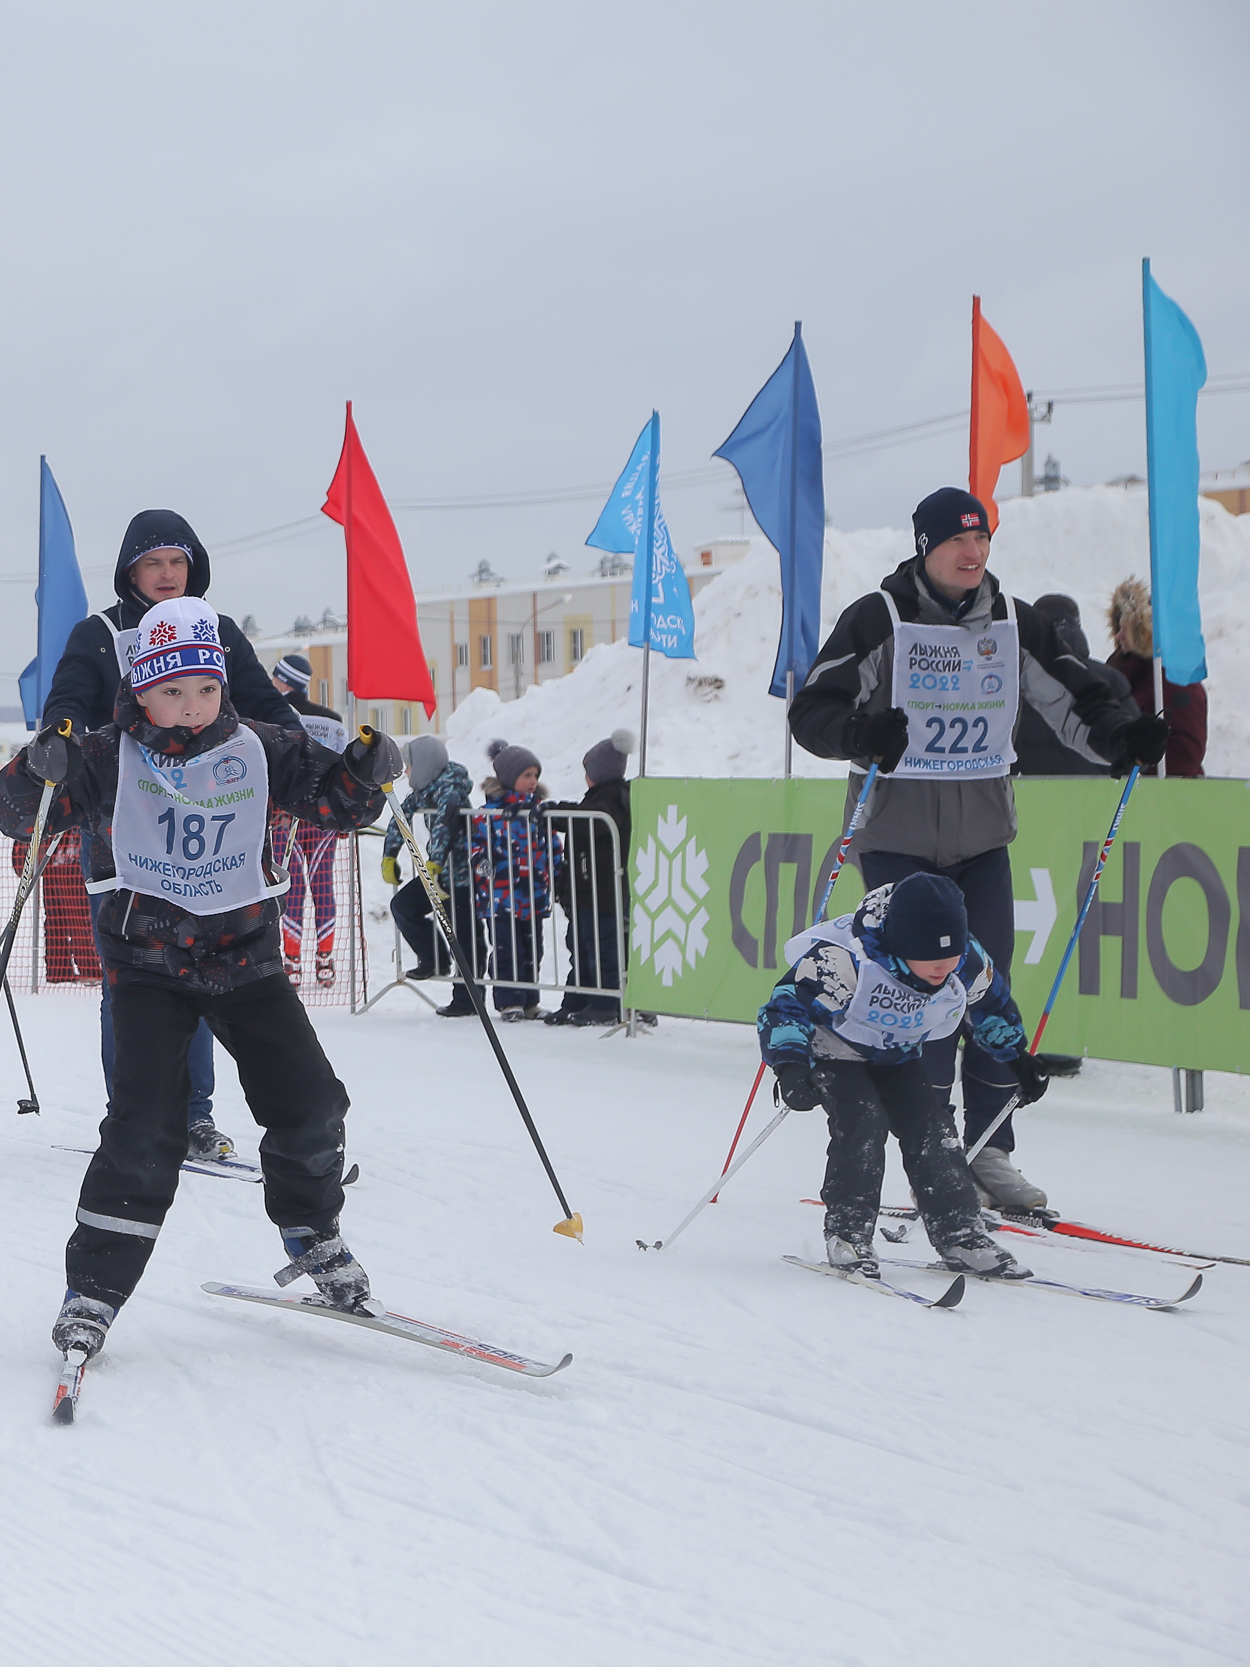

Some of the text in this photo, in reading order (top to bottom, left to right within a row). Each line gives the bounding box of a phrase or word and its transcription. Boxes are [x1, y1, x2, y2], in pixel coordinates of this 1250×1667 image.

[908, 642, 962, 658] ЛЫЖНЯ
[908, 657, 962, 673] РОССИИ
[908, 673, 961, 691] 2022
[924, 715, 990, 754] 222
[904, 754, 1005, 771] НИЖЕГОРОДСКАЯ
[213, 787, 255, 808] ЖИЗНИ
[157, 806, 236, 862] 187
[128, 852, 246, 881] НИЖЕГОРОДСКАЯ
[161, 879, 223, 898] ОБЛАСТЬ
[866, 1009, 924, 1029] 2022
